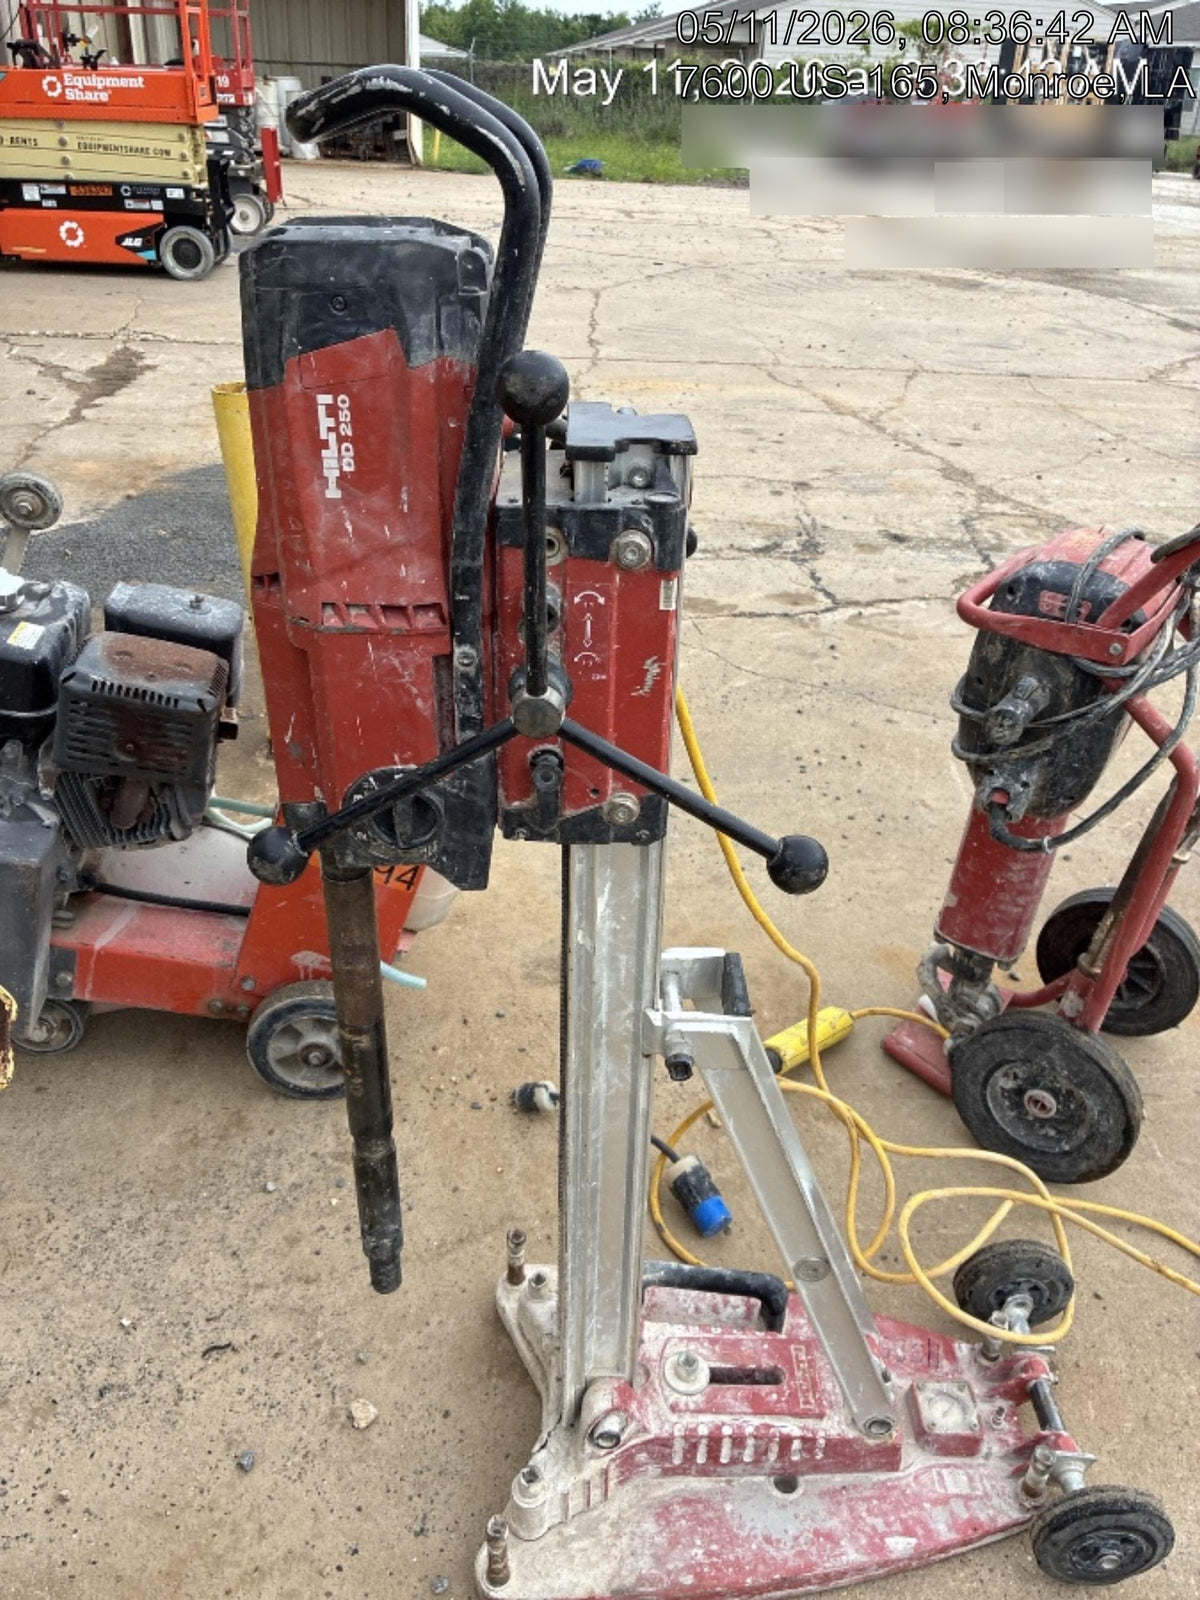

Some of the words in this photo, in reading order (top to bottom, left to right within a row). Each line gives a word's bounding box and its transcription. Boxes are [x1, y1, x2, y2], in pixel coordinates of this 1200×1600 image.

[63, 73, 145, 89] Equipment
[65, 88, 109, 102] Share
[337, 394, 352, 437] 250
[316, 394, 342, 499] HILTI
[341, 442, 355, 472] DD
